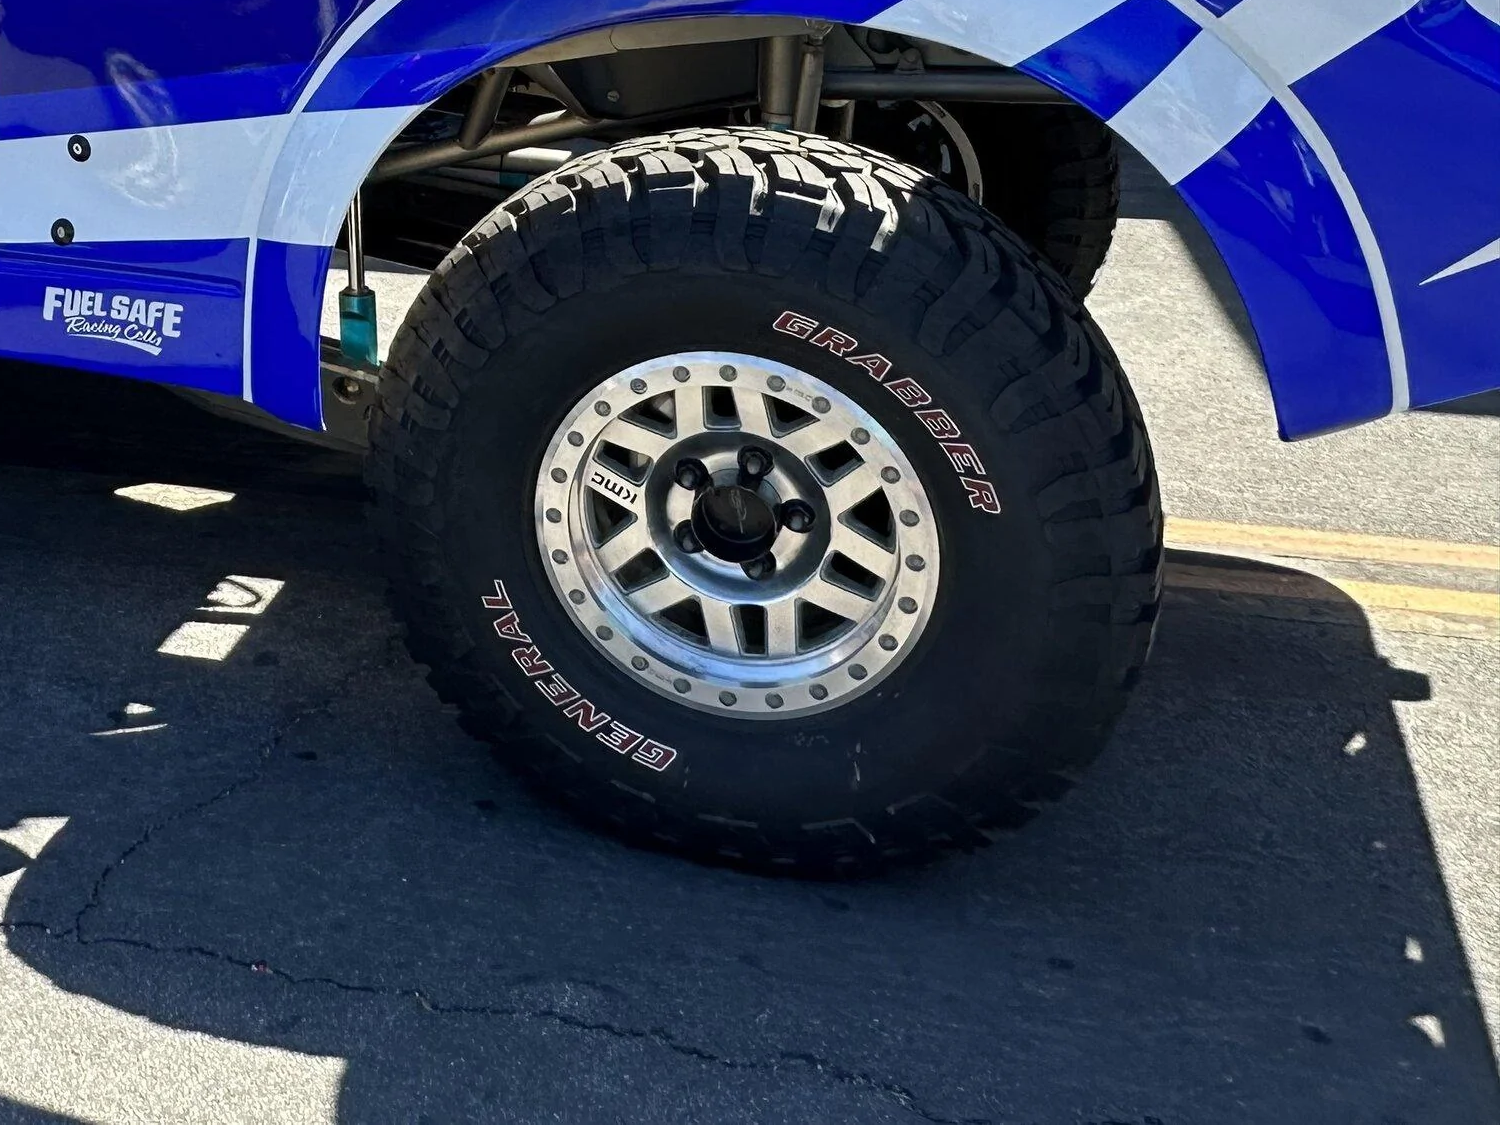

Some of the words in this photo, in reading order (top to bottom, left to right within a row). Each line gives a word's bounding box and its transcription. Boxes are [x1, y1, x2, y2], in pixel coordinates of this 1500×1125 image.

[43, 286, 107, 321] FUEL
[110, 295, 184, 338] SAFE
[65, 316, 121, 339] Racing
[773, 311, 1001, 515] GRABBER
[481, 579, 678, 772] GENERAL
